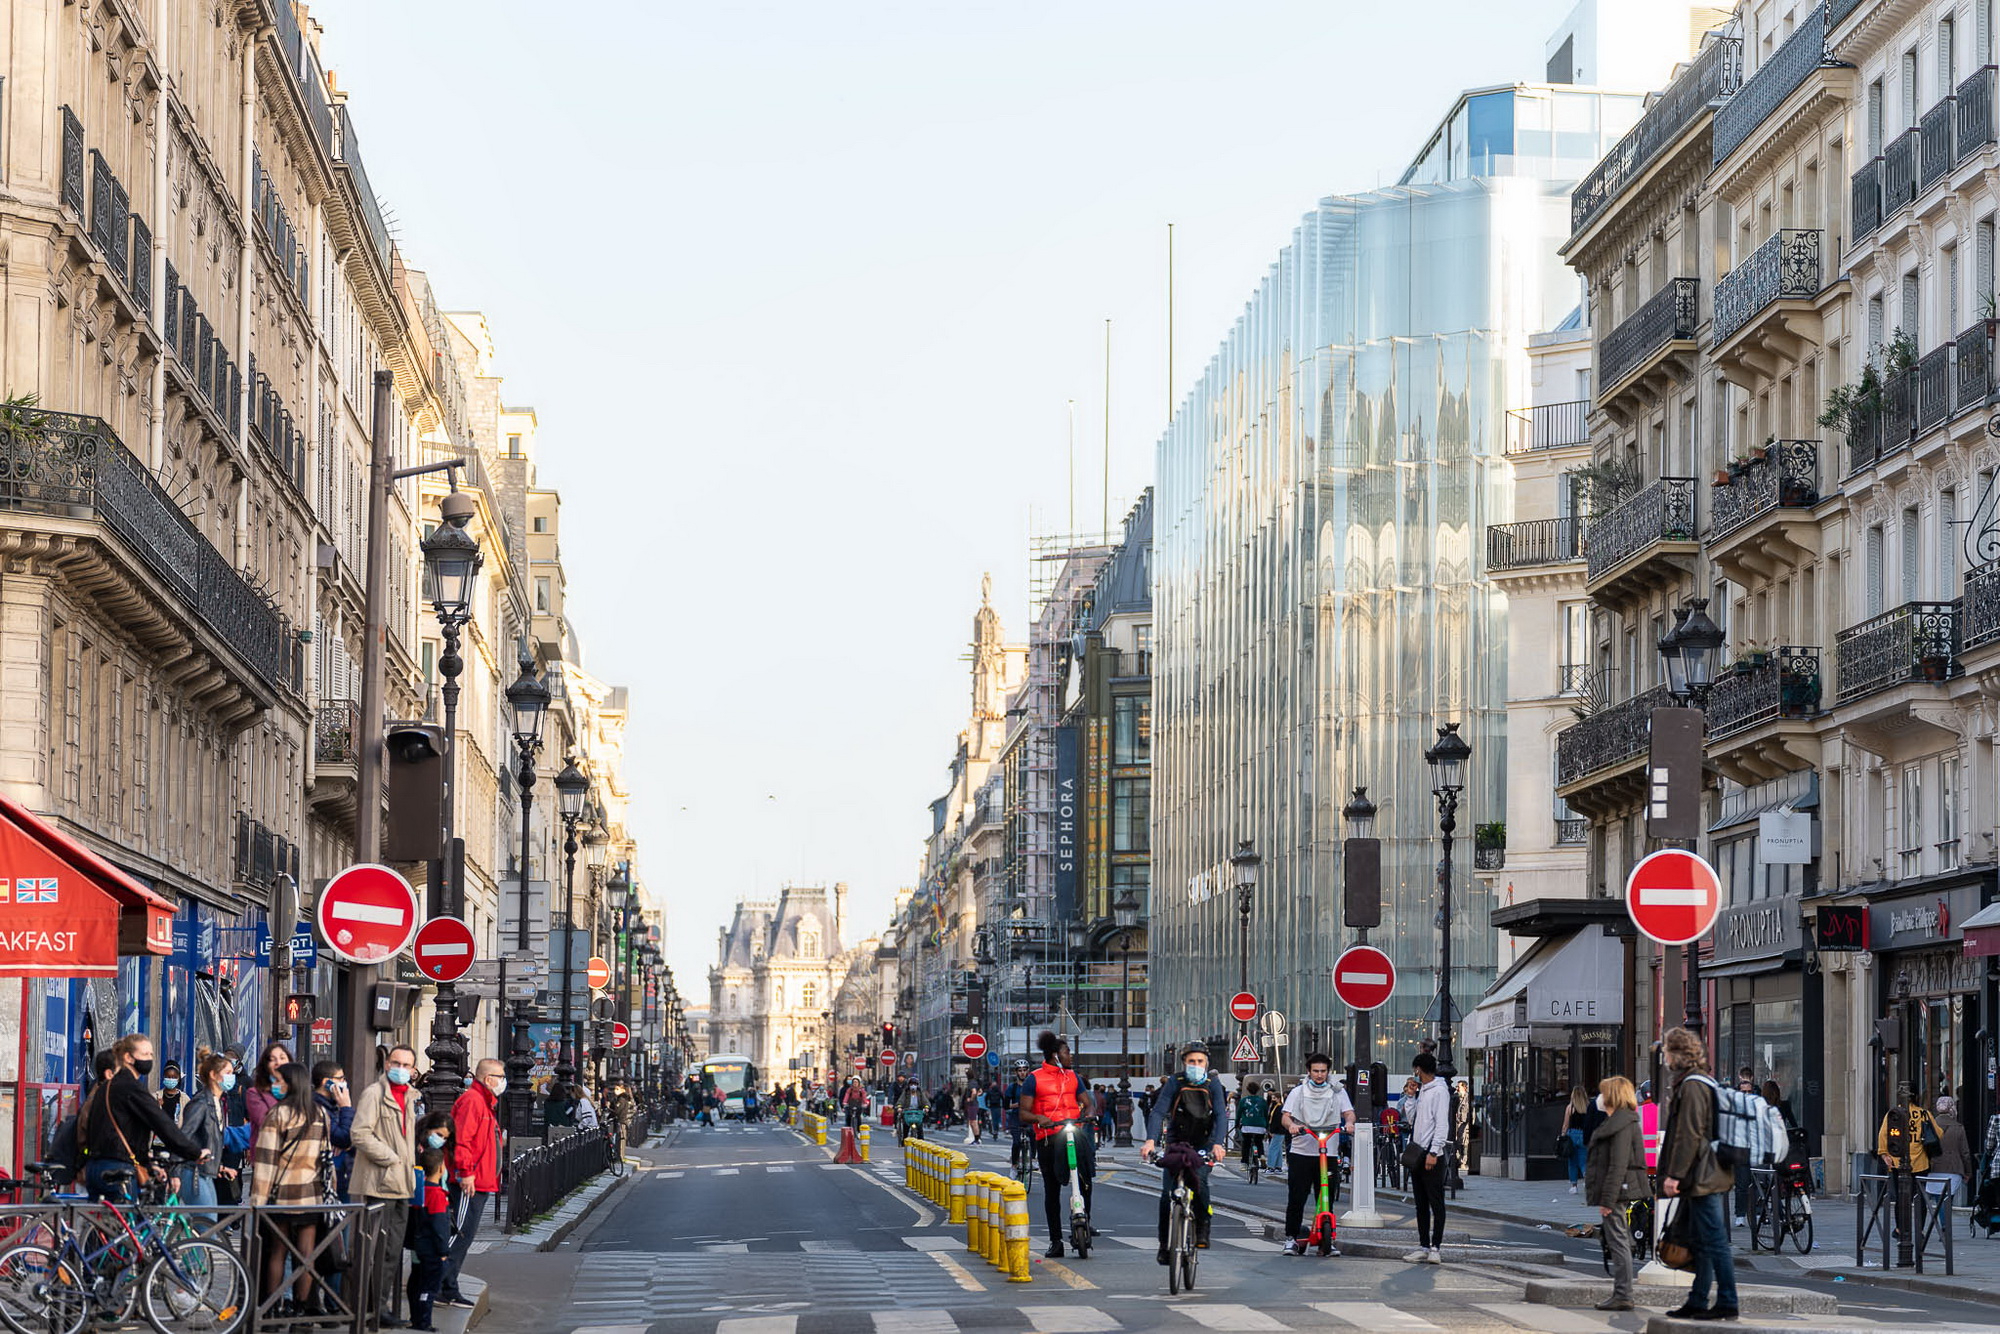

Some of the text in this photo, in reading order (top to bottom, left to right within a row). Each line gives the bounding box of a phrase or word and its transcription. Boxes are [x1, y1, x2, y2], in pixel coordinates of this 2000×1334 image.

[1060, 778, 1073, 871] SEPHORA
[0, 931, 77, 951] AKFAST
[1728, 907, 1783, 950] PRONUPTIA
[1551, 1000, 1596, 1017] CAFE
